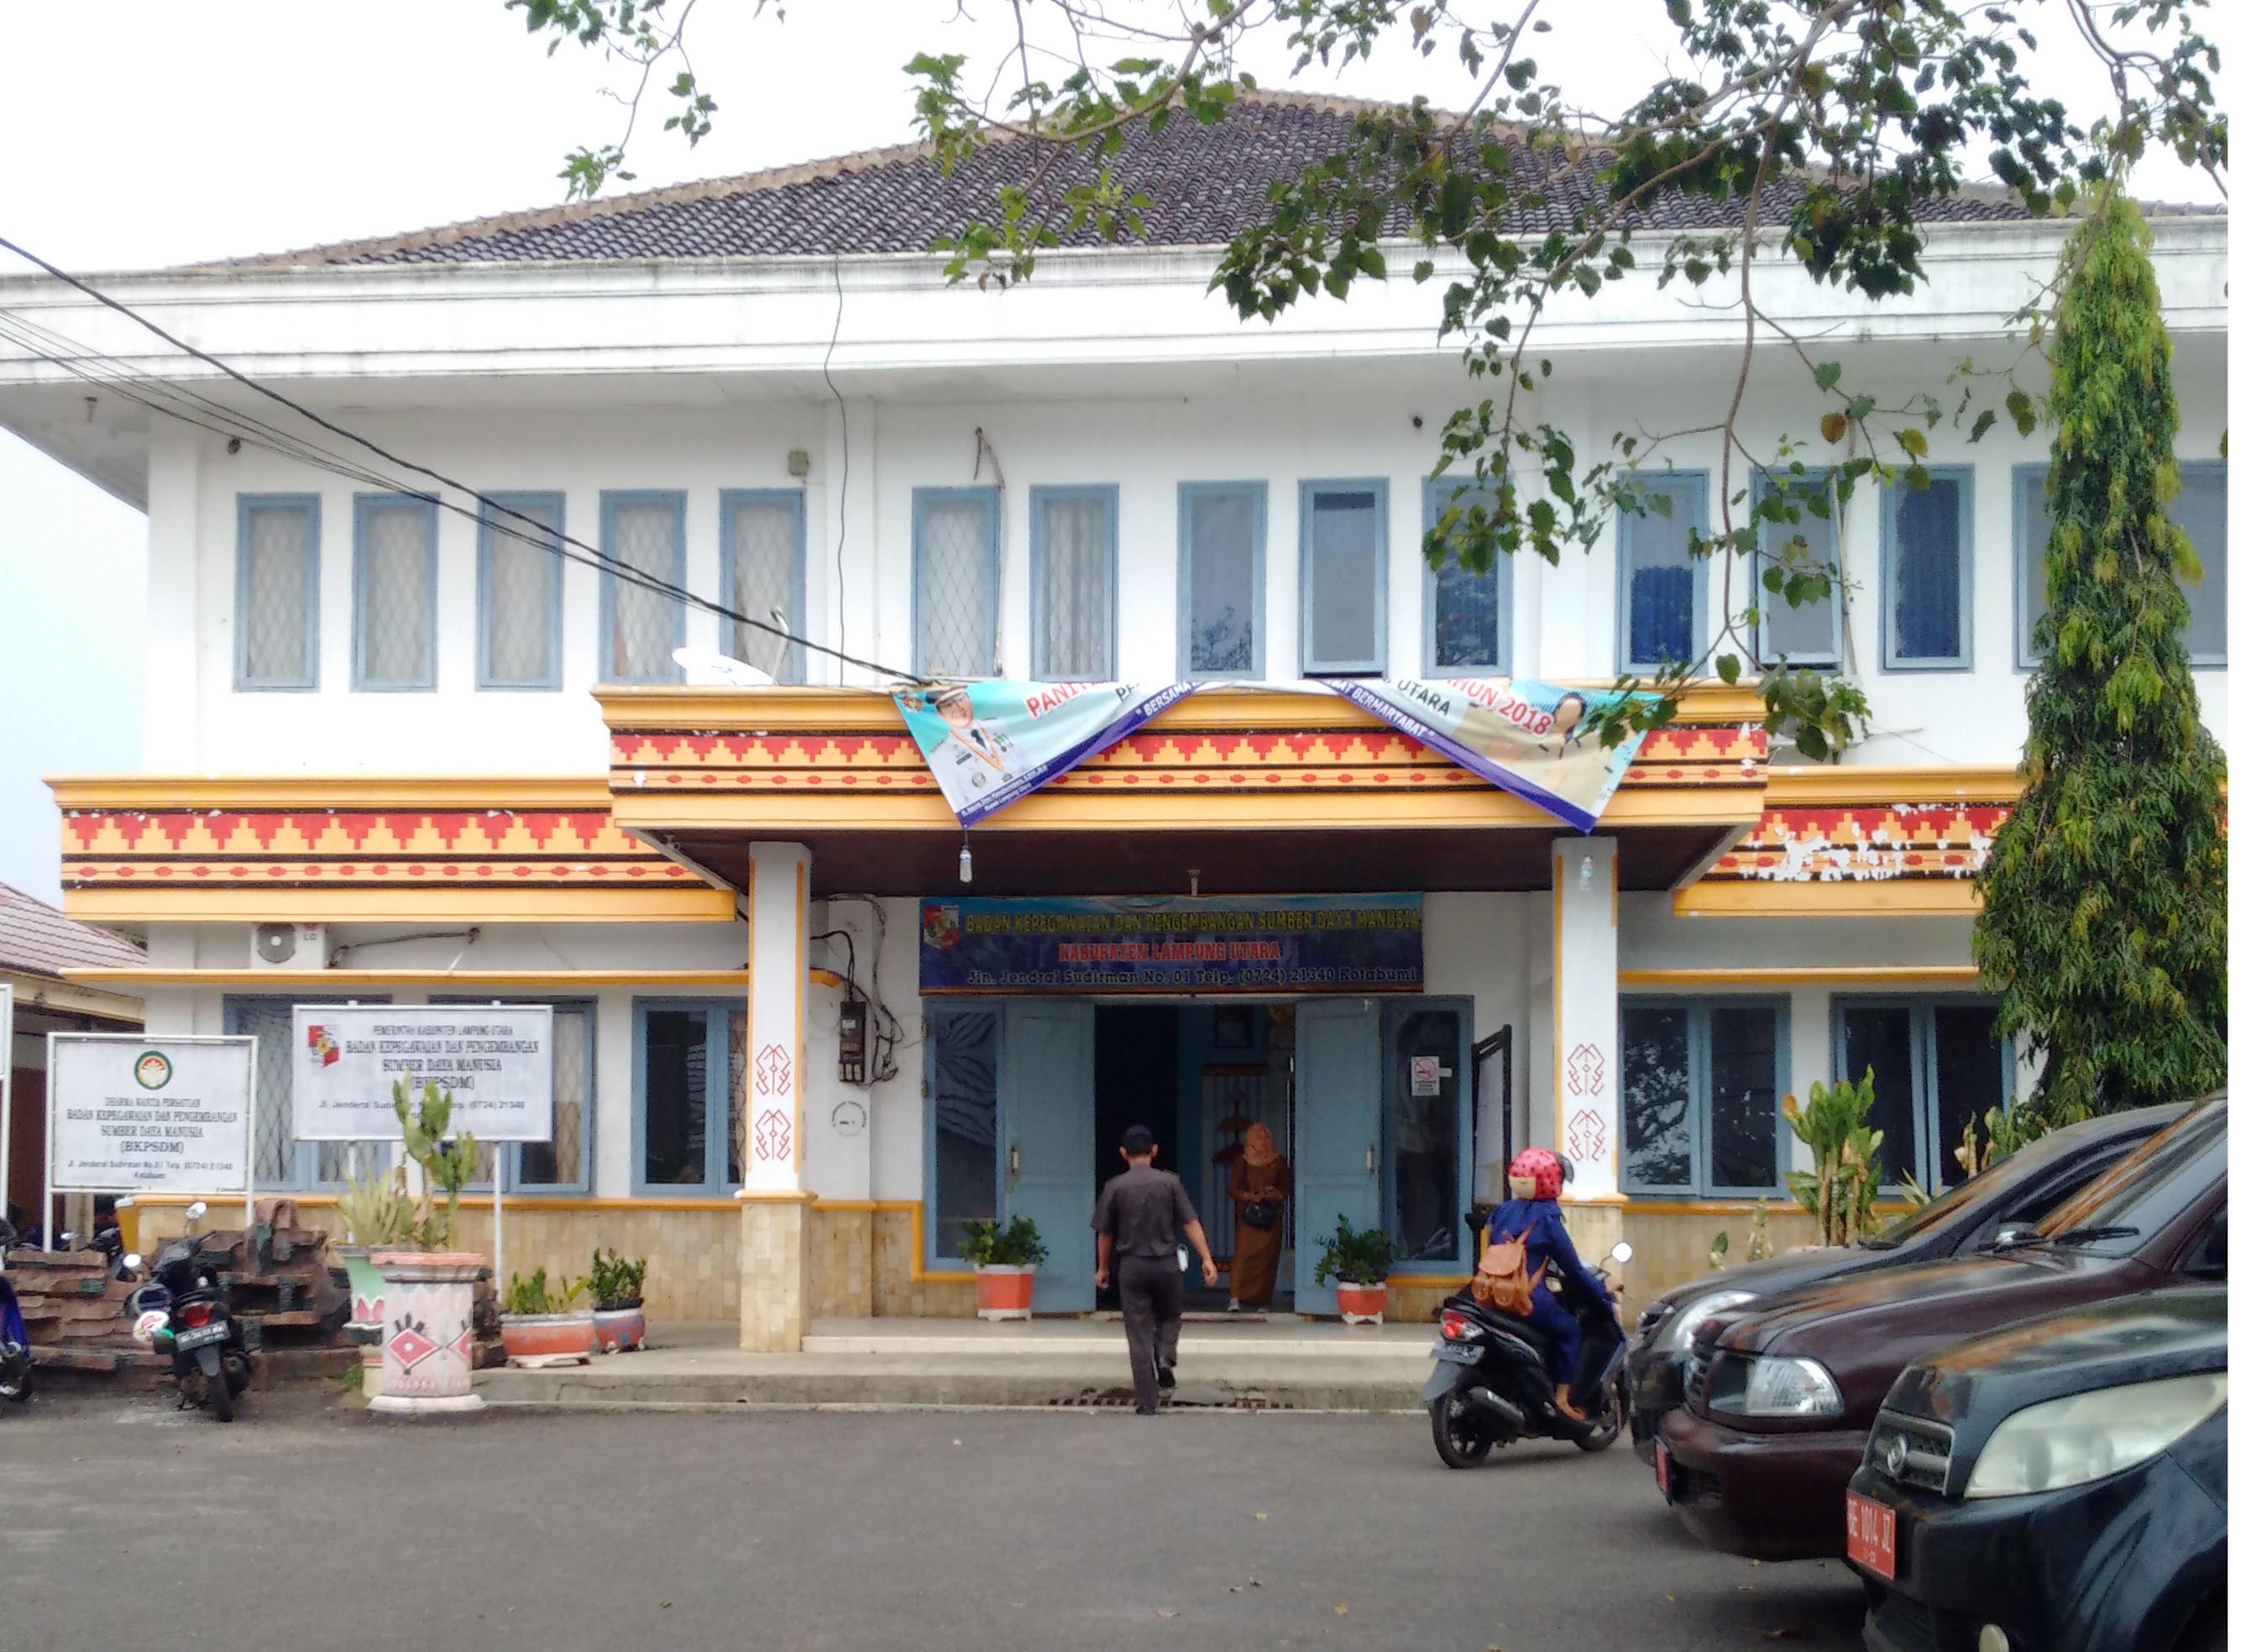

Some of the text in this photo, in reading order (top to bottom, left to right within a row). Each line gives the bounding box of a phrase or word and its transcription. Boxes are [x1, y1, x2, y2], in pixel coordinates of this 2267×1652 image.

[1026, 682, 1107, 718] PANI
[1397, 679, 1451, 716] UTARA
[1447, 678, 1552, 735] HUN 2018
[966, 908, 1420, 933] BADAN KEPEGAWAIAN DAN PENGEMBANGAN SUMBER DAYA MANUSIA
[1058, 942, 1280, 961] KABUPATEN LAMPUNG UTARA
[1064, 970, 1138, 984] Sudirman
[1144, 969, 1170, 983] No.
[1174, 969, 1191, 983] 01
[1238, 968, 1285, 986] (0724)
[1291, 968, 1334, 982] 21340
[1340, 966, 1416, 982] Kotabumi
[345, 1040, 540, 1053] BADAN KEPEGAWAIAN DAN PENGEMBANGAN
[383, 1059, 503, 1071] SUMBER DAYA MANUSIA
[67, 1109, 94, 1120] BADAN
[155, 1111, 171, 1121] DAN
[101, 1125, 204, 1137] SUMBER DAYA MANUSIA
[120, 1141, 185, 1154] (BKPSDM)
